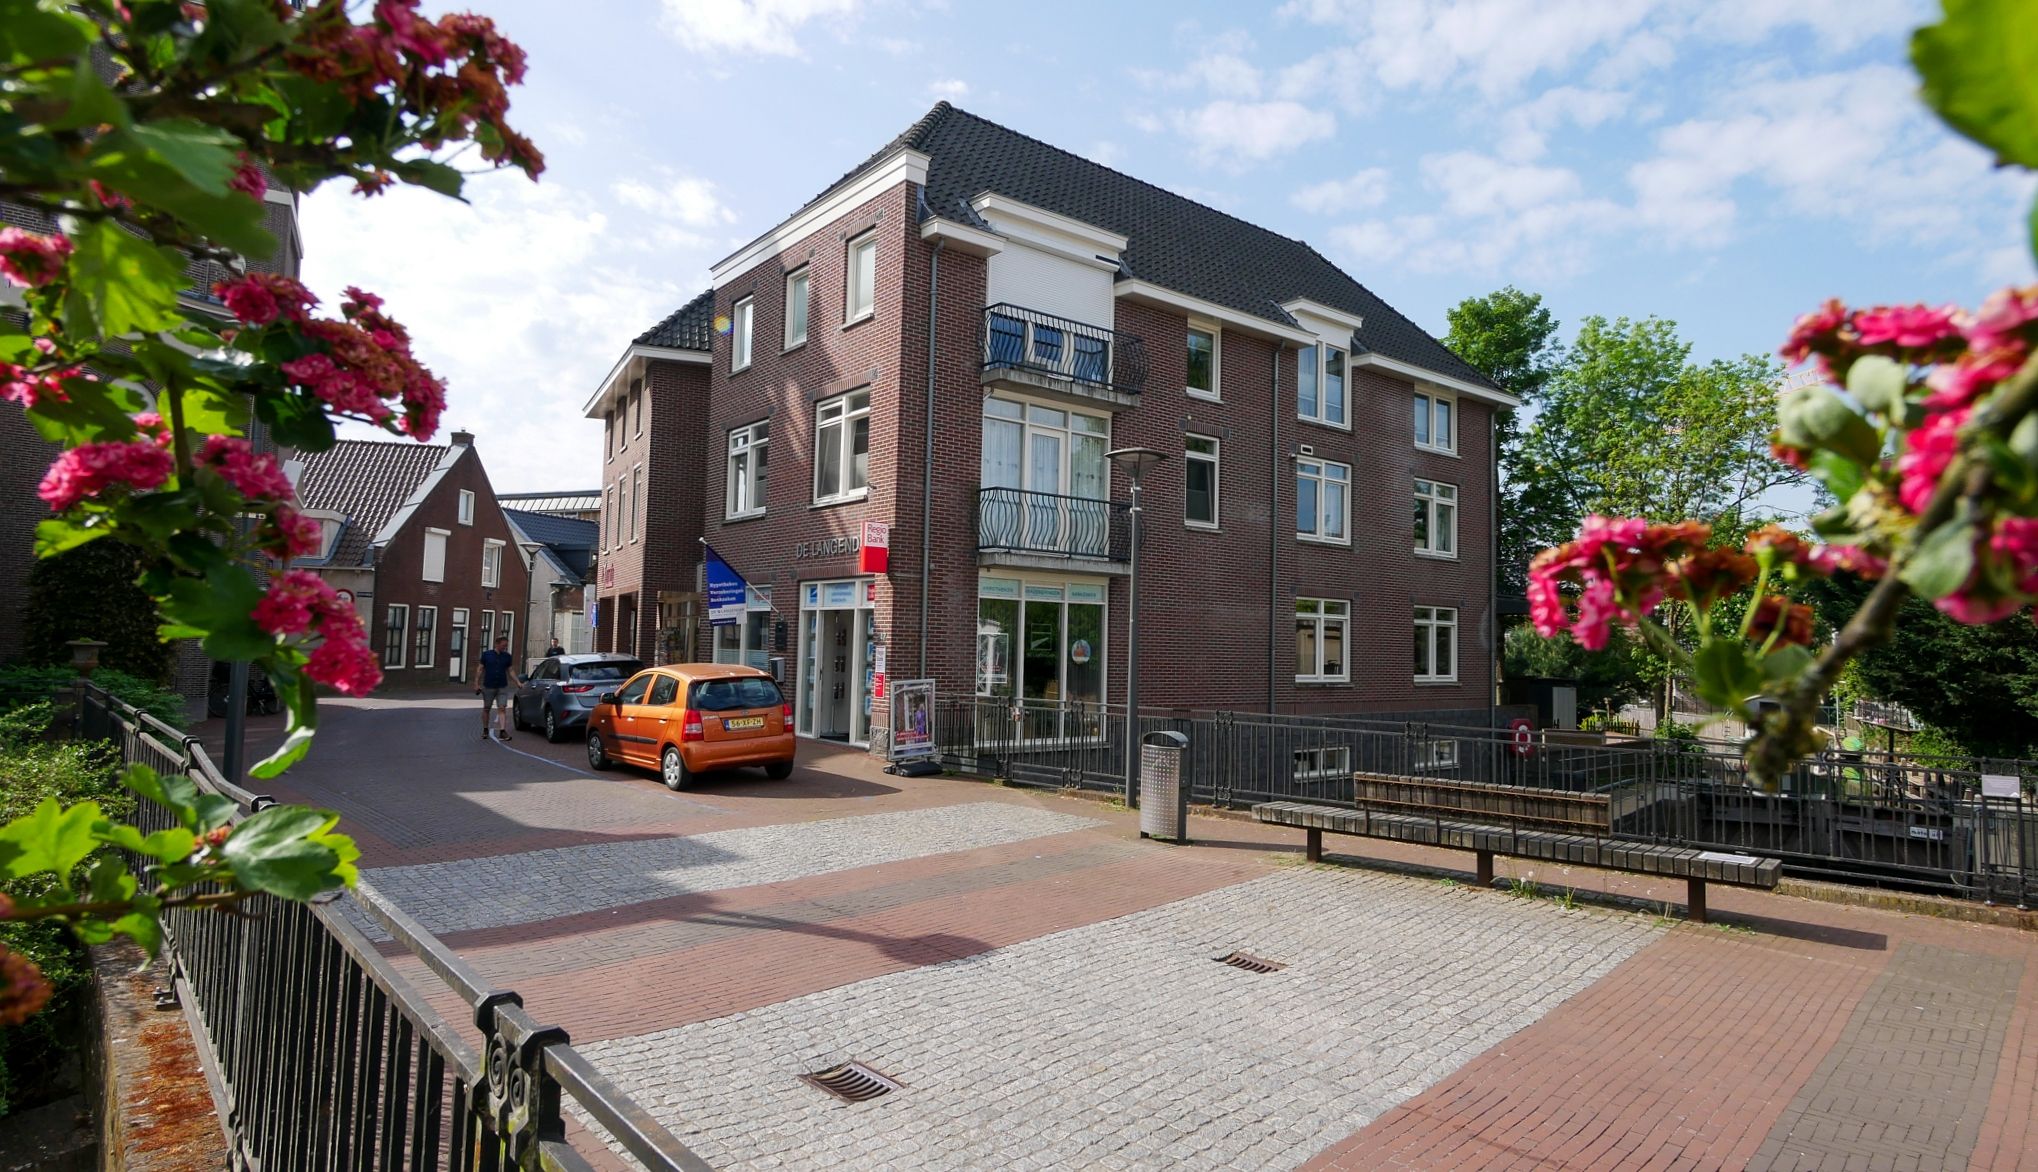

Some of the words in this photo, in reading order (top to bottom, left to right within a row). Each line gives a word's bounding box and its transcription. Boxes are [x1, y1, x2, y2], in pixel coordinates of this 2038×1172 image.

[867, 524, 886, 535] Regio
[867, 534, 884, 543] Bank
[796, 542, 809, 558] DE
[812, 536, 860, 556] LANGEND
